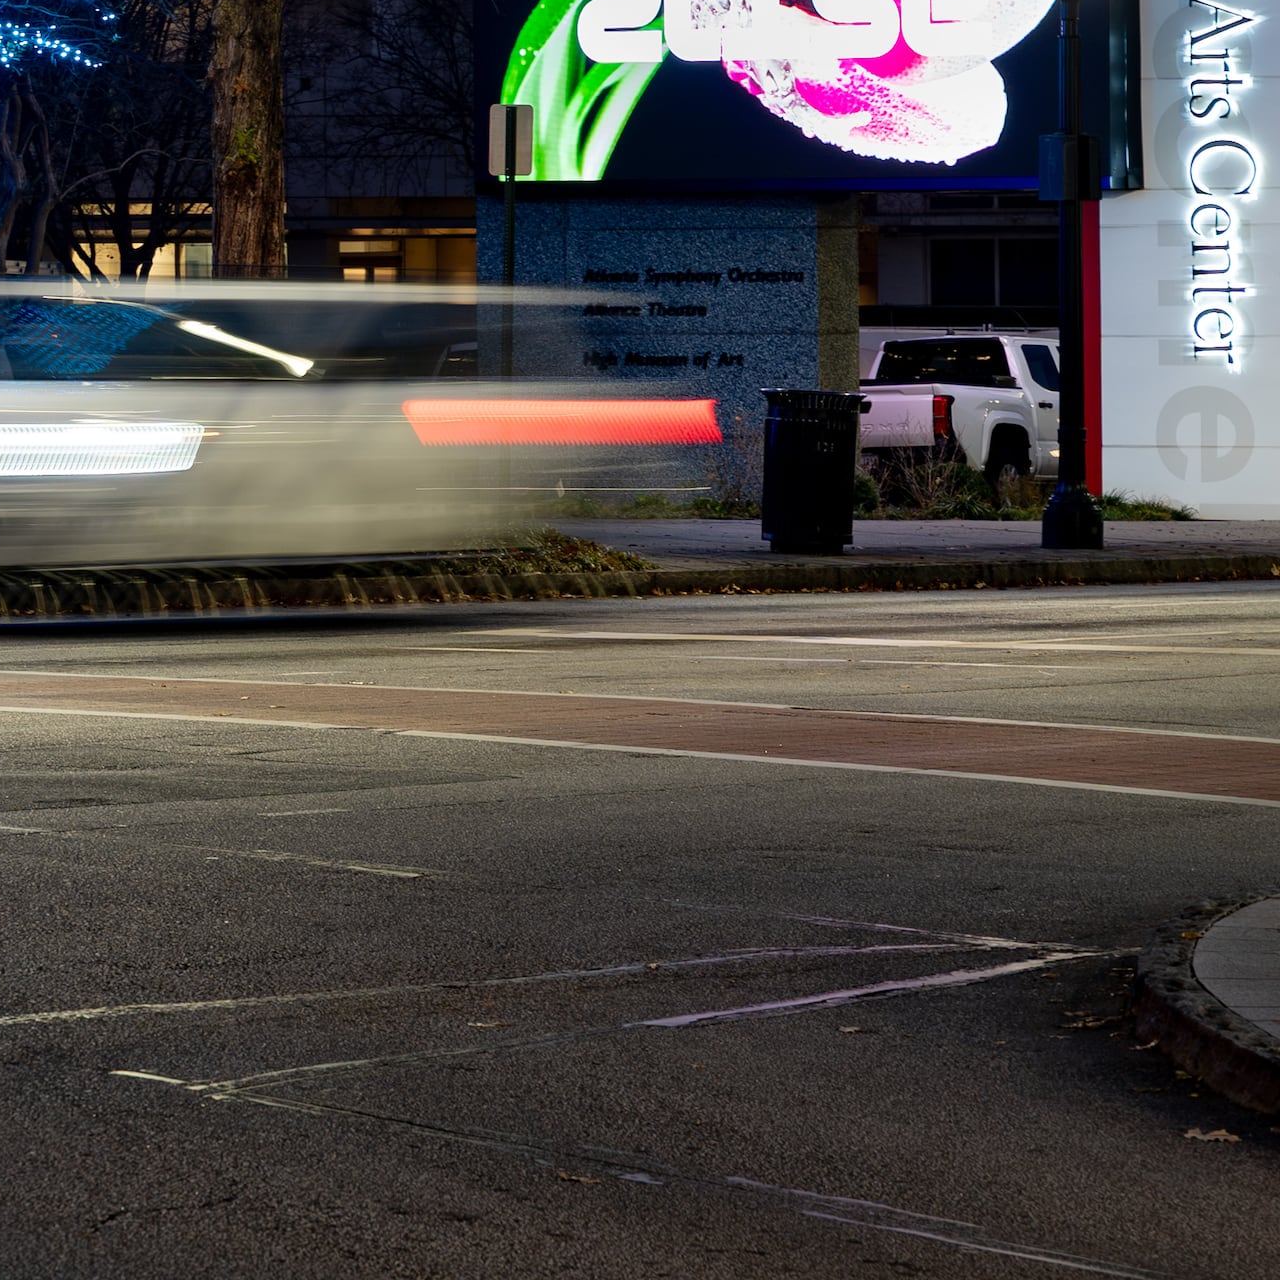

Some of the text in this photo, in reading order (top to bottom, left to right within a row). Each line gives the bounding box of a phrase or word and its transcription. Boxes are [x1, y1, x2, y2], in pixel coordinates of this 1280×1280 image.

[1188, 138, 1258, 365] Center
[645, 268, 722, 287] Symphony
[727, 267, 804, 283] Orchestra
[648, 302, 707, 317] Theatre
[693, 352, 711, 369] of
[718, 352, 744, 367] Art
